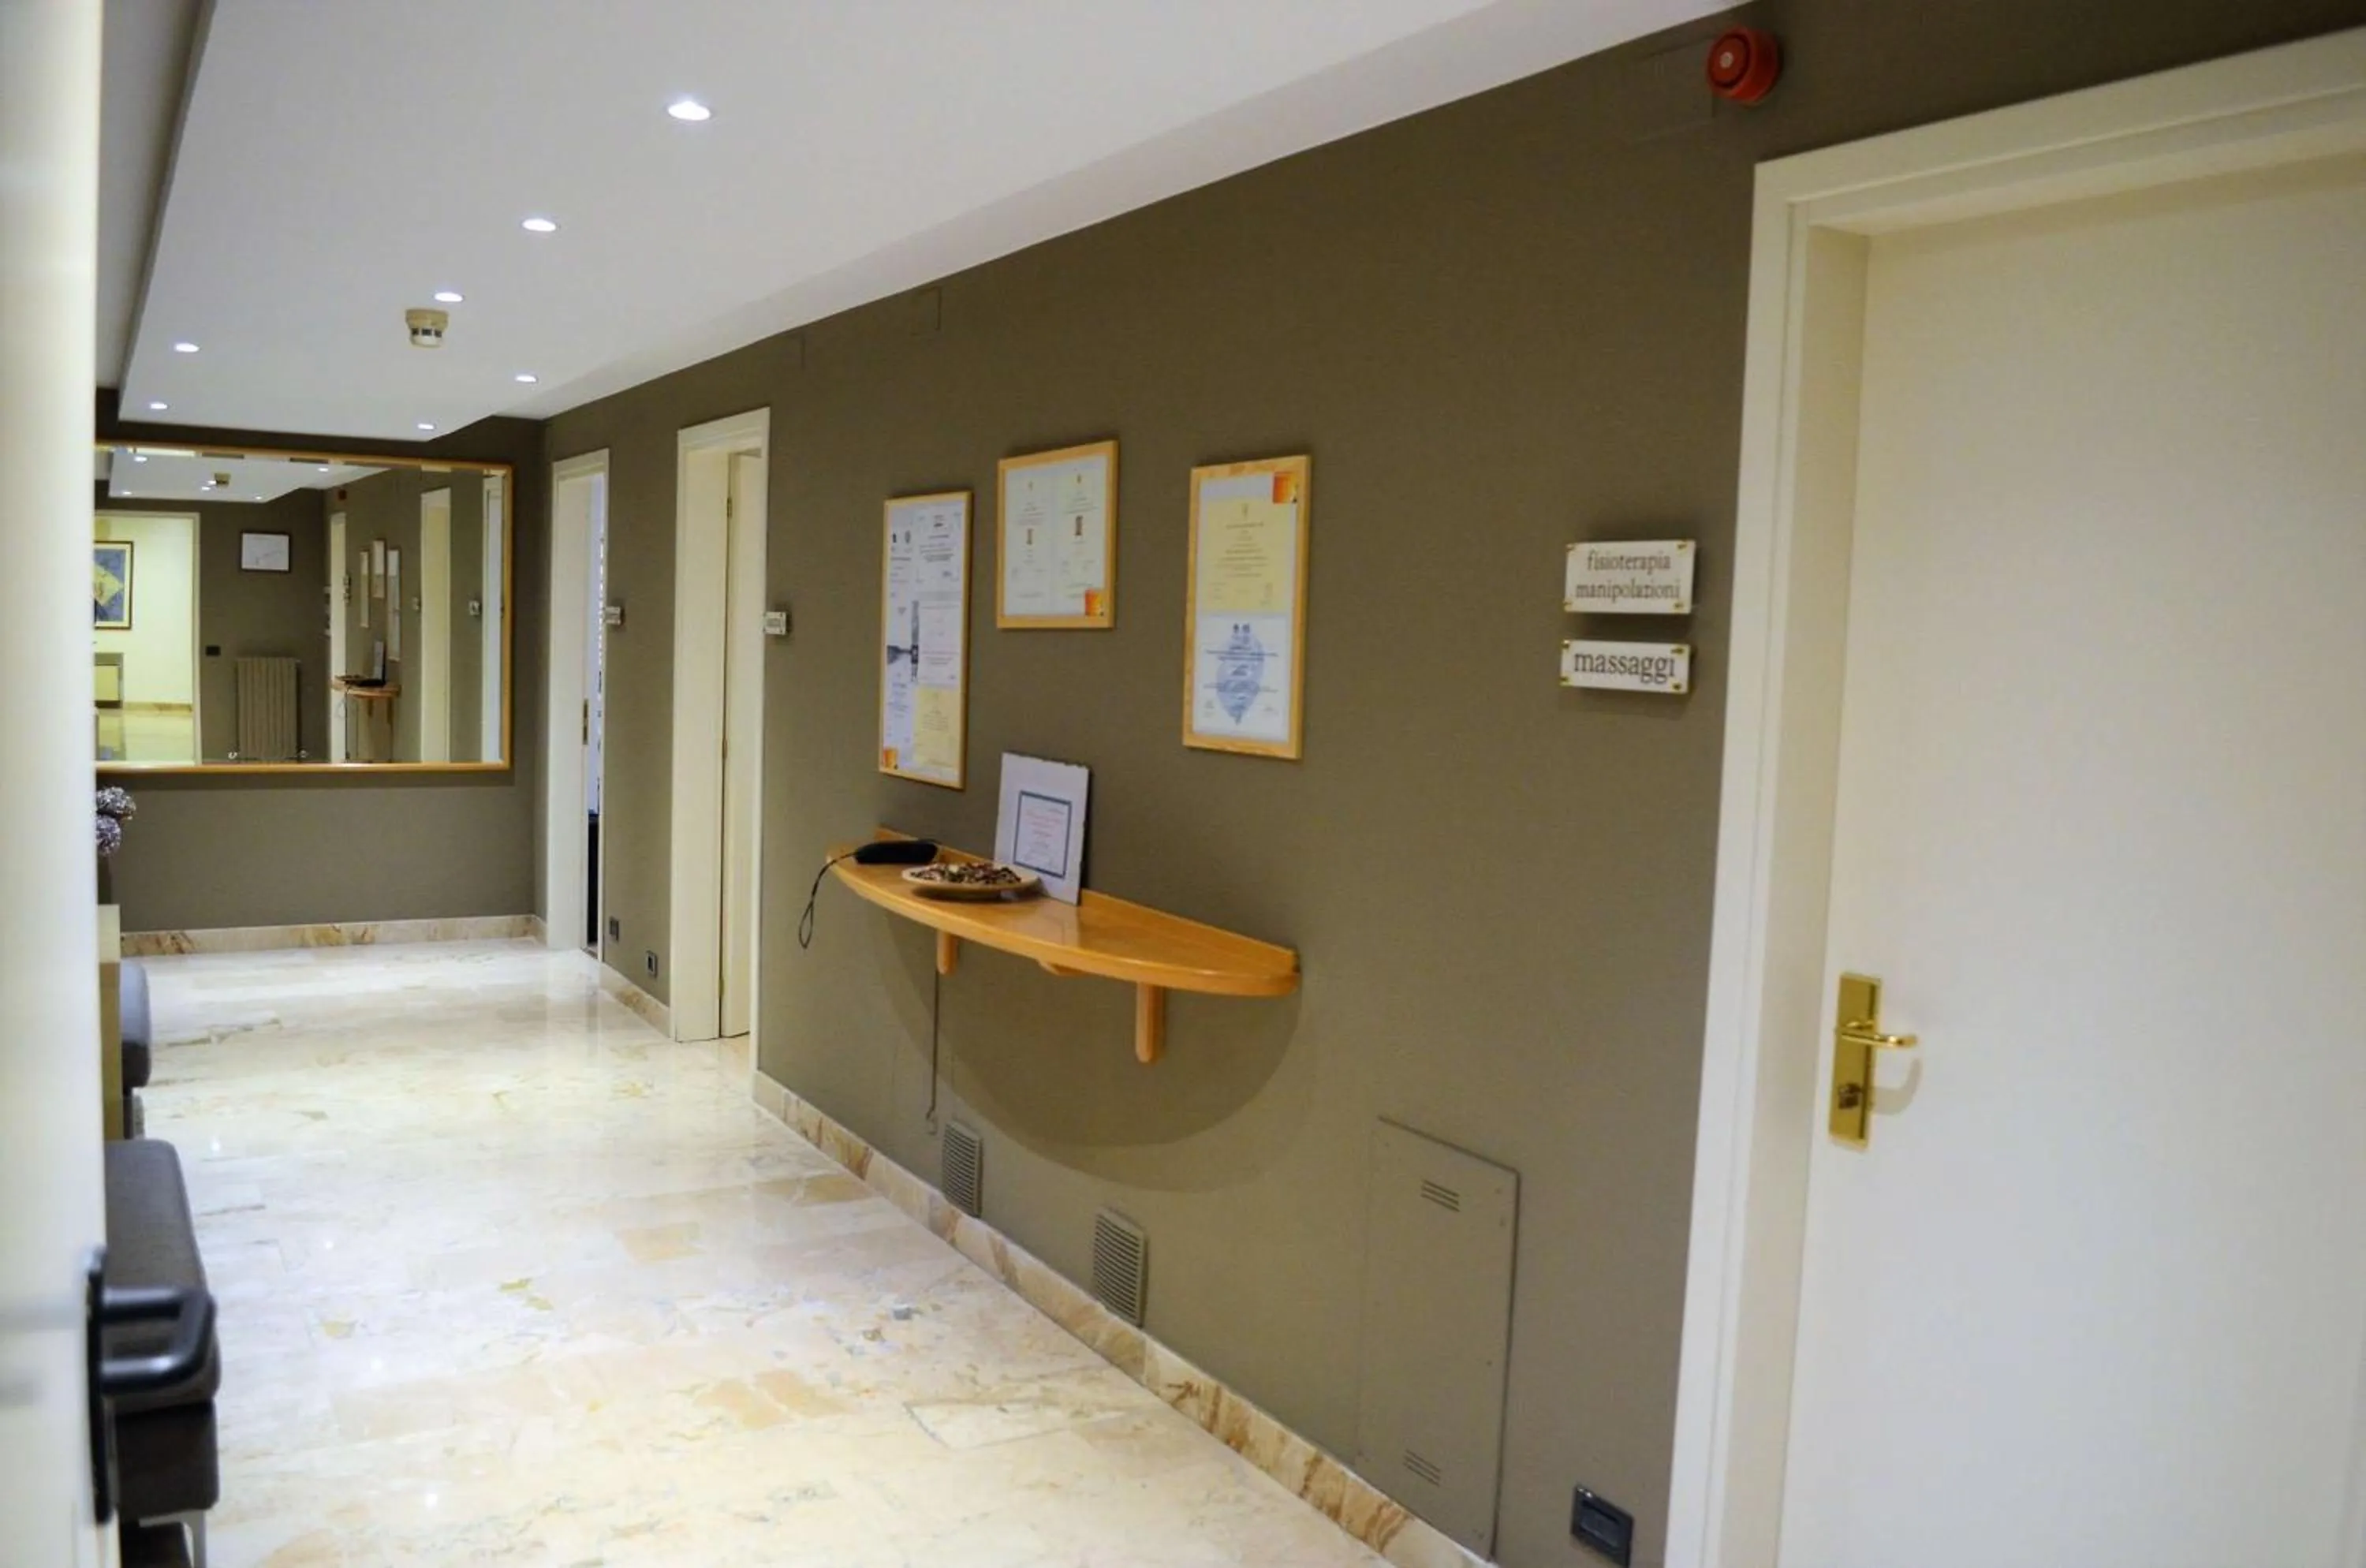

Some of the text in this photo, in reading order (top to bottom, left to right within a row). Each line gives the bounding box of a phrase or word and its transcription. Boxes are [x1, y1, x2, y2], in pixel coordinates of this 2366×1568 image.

[1587, 550, 1671, 575] fisioterapia
[1575, 577, 1681, 603] manipolazioni
[1573, 652, 1675, 684] massaggi
